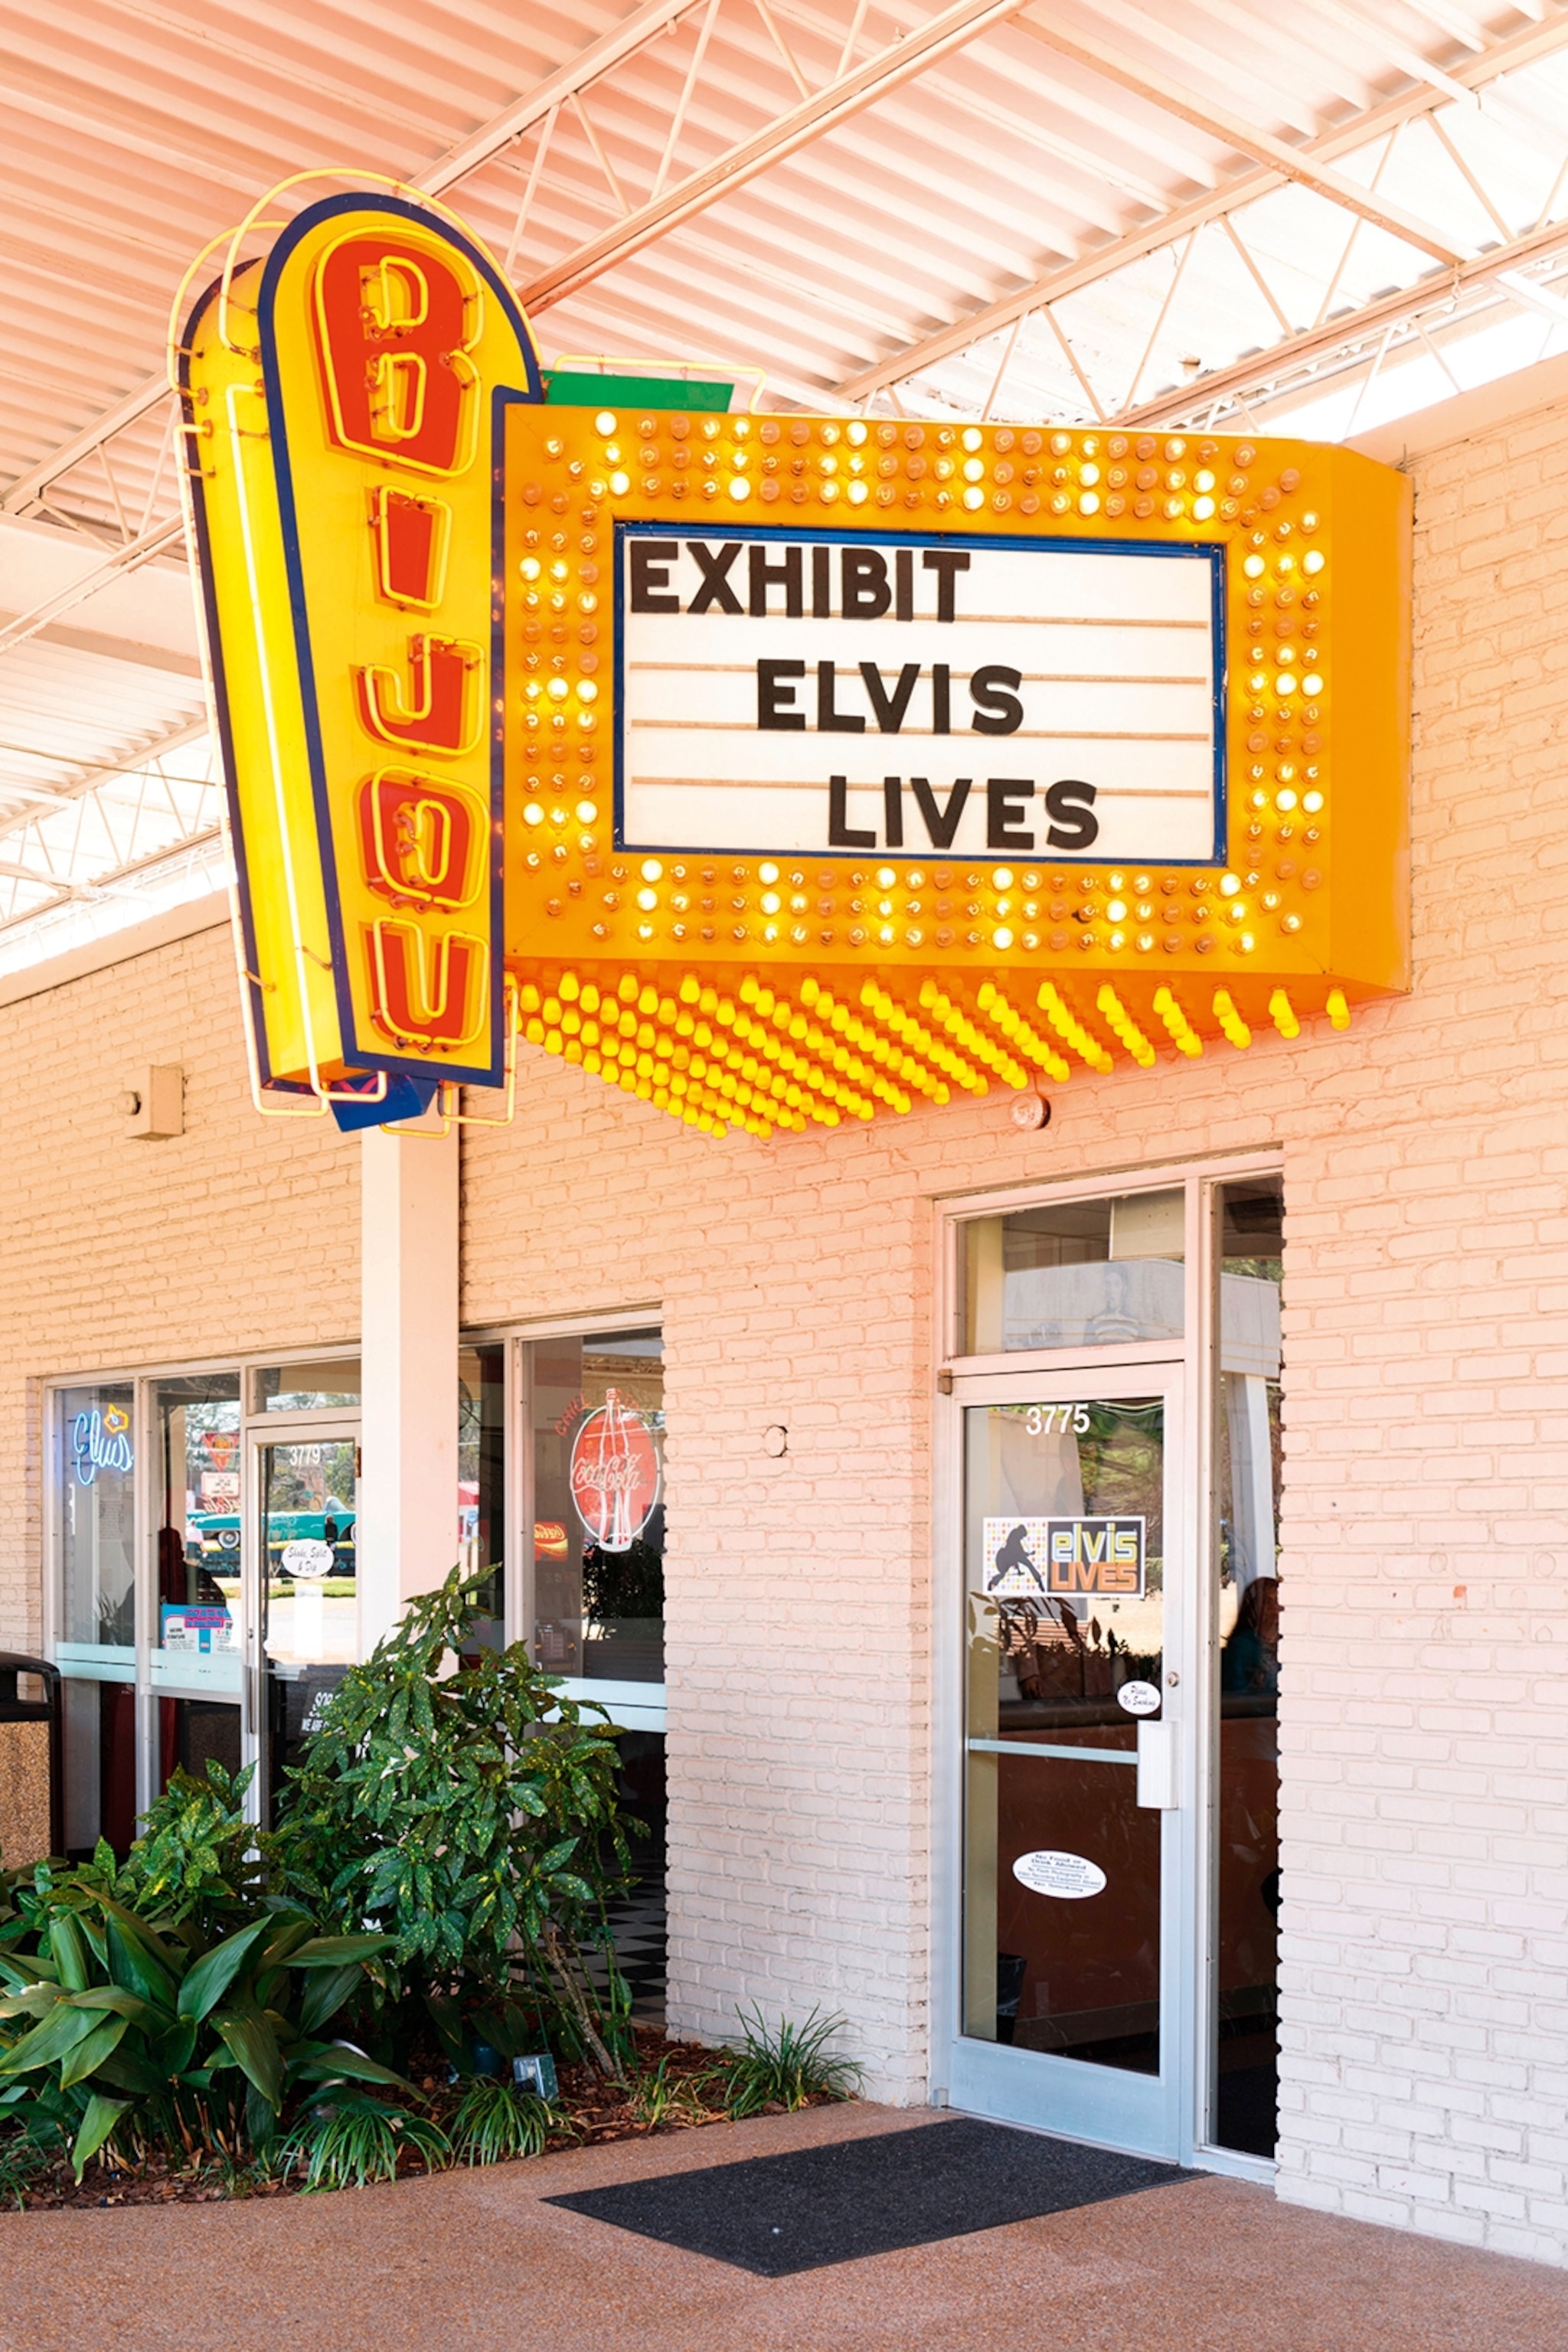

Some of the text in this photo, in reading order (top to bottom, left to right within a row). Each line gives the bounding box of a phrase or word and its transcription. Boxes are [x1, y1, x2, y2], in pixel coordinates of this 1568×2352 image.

[630, 541, 971, 623] EXHIBIT
[311, 224, 489, 1047] BIJOU
[757, 658, 1024, 736] ELVIS
[828, 775, 1099, 850] LIVES
[1026, 1403, 1090, 1436] 3775
[290, 1444, 321, 1465] 3779
[1052, 1522, 1138, 1563] elvis
[1051, 1562, 1138, 1592] LIVES
